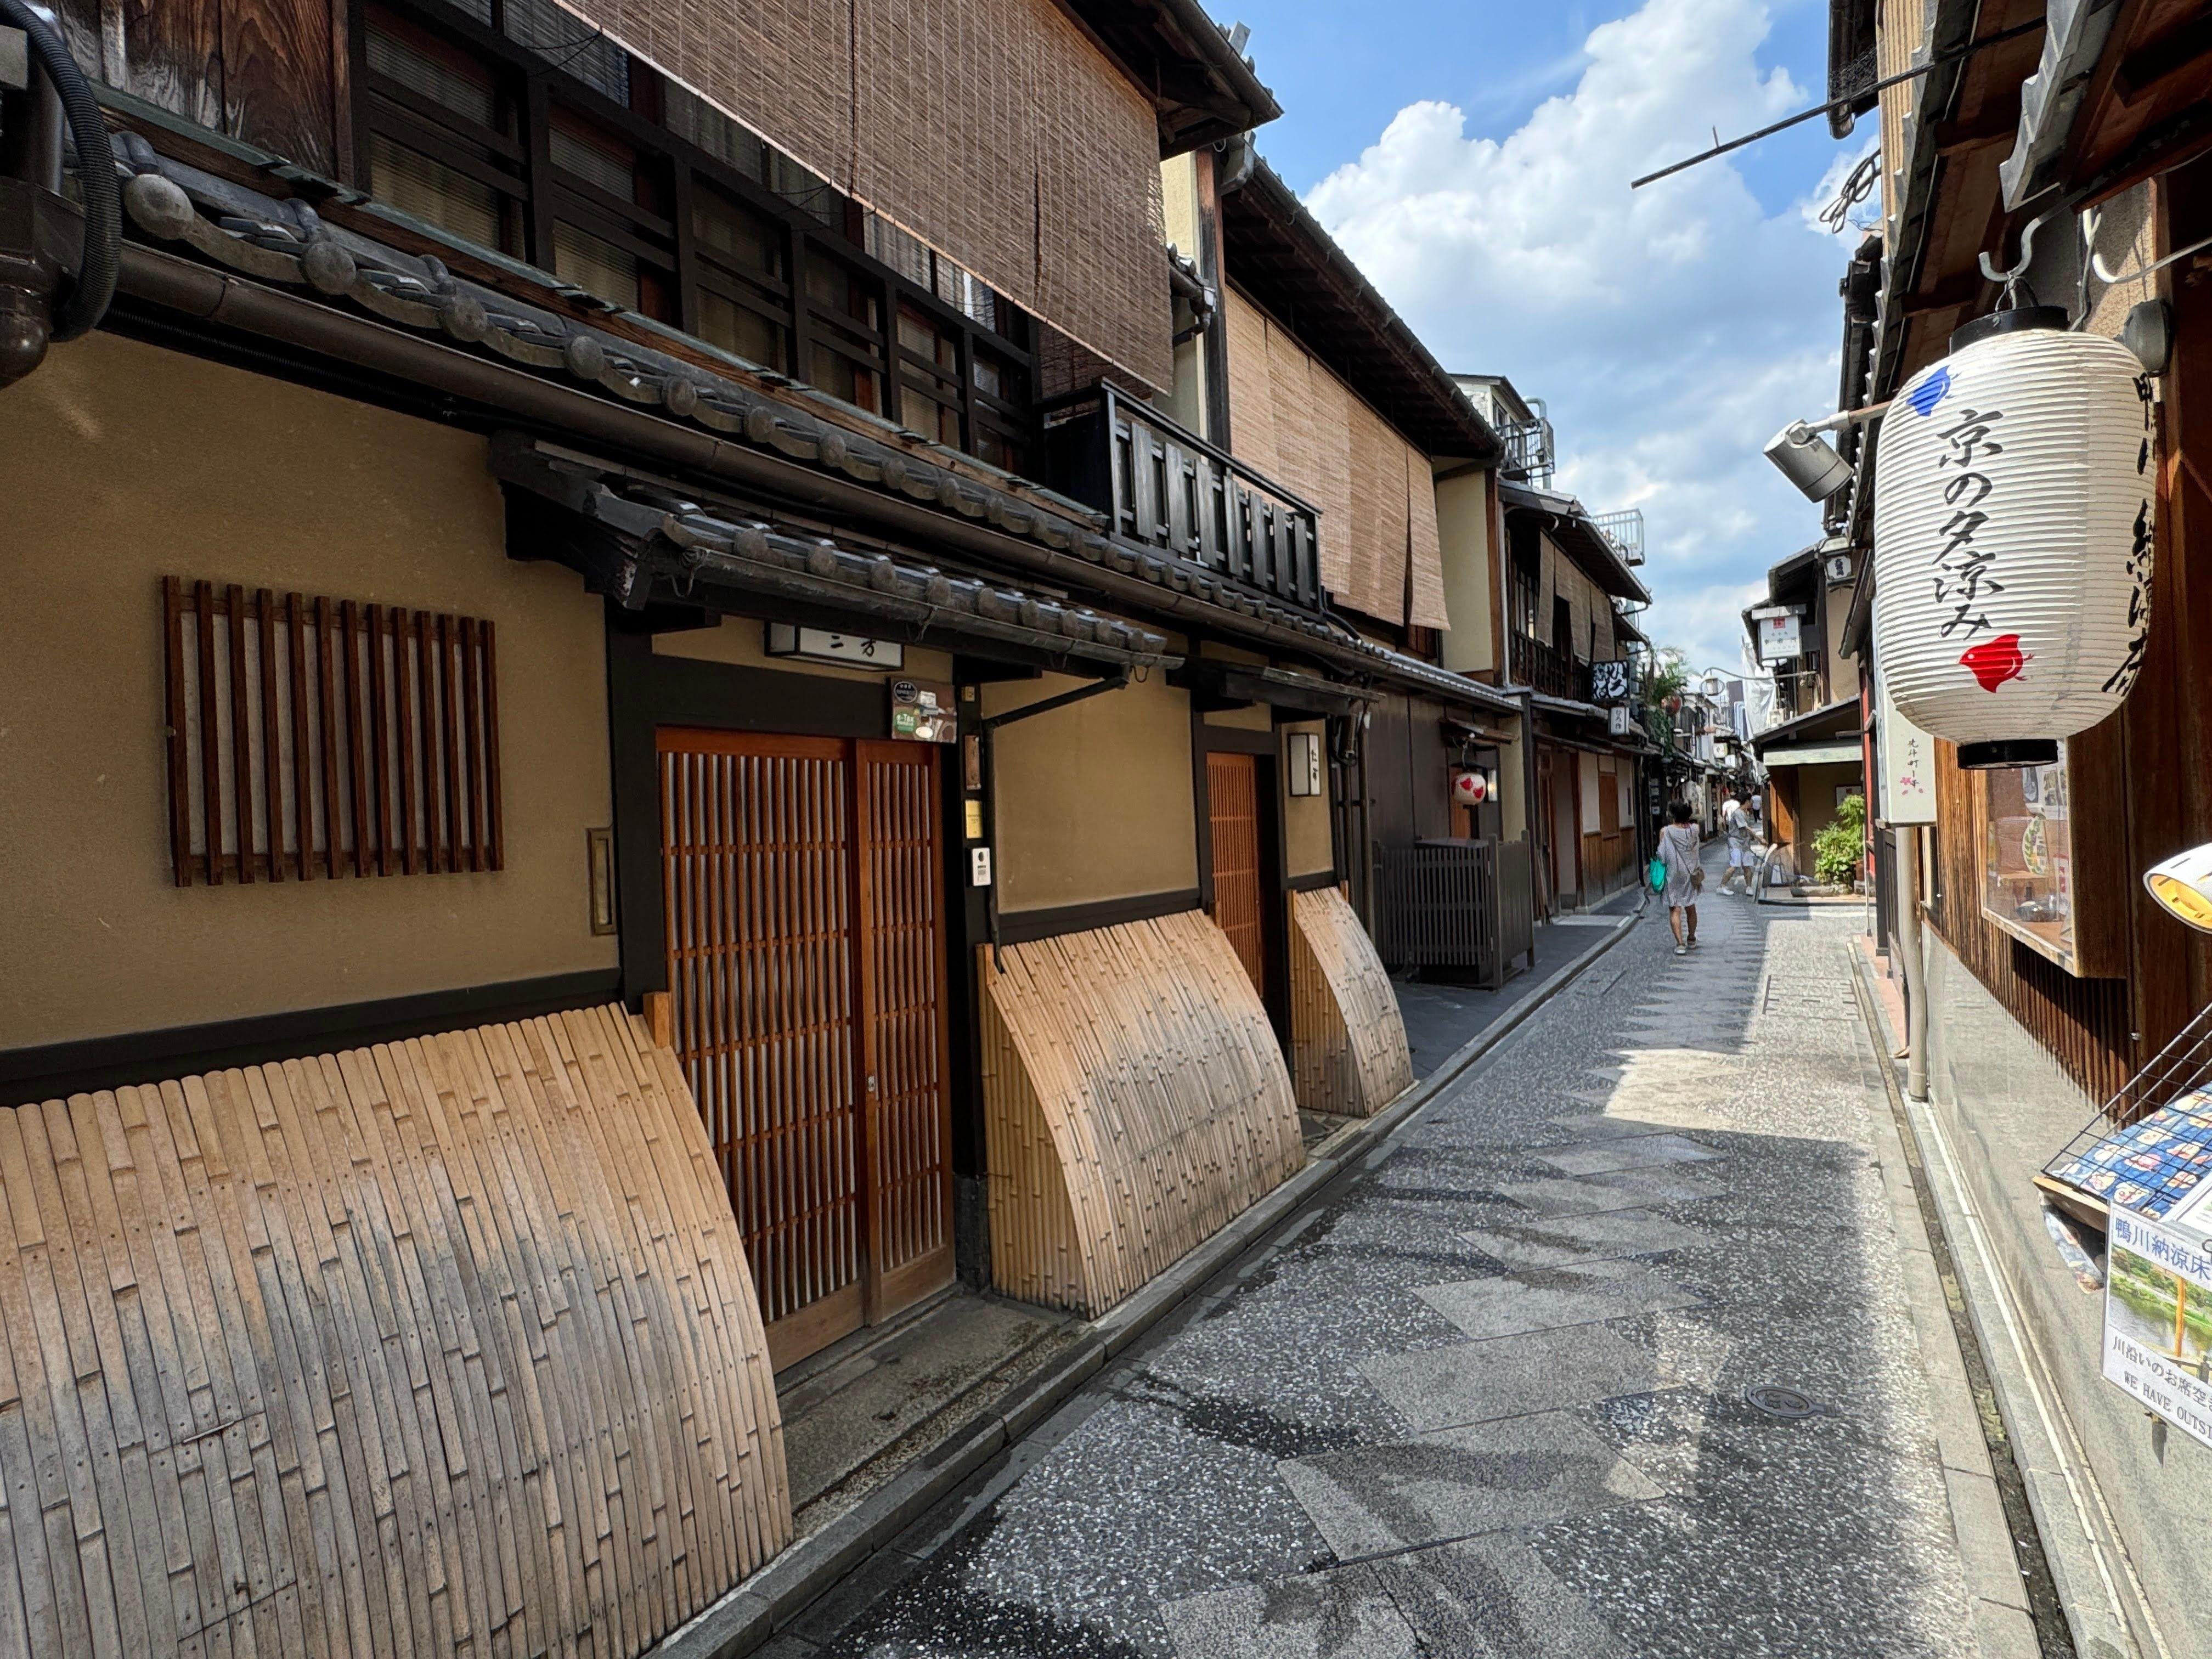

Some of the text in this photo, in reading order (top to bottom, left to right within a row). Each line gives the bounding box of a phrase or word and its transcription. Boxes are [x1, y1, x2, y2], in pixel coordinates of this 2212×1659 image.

[1931, 408, 2006, 641] 京の夕涼み
[2115, 1217, 2211, 1280] 鴨川納涼床
[2124, 1370, 2138, 1390] WE
[2143, 1382, 2171, 1412] HAVE
